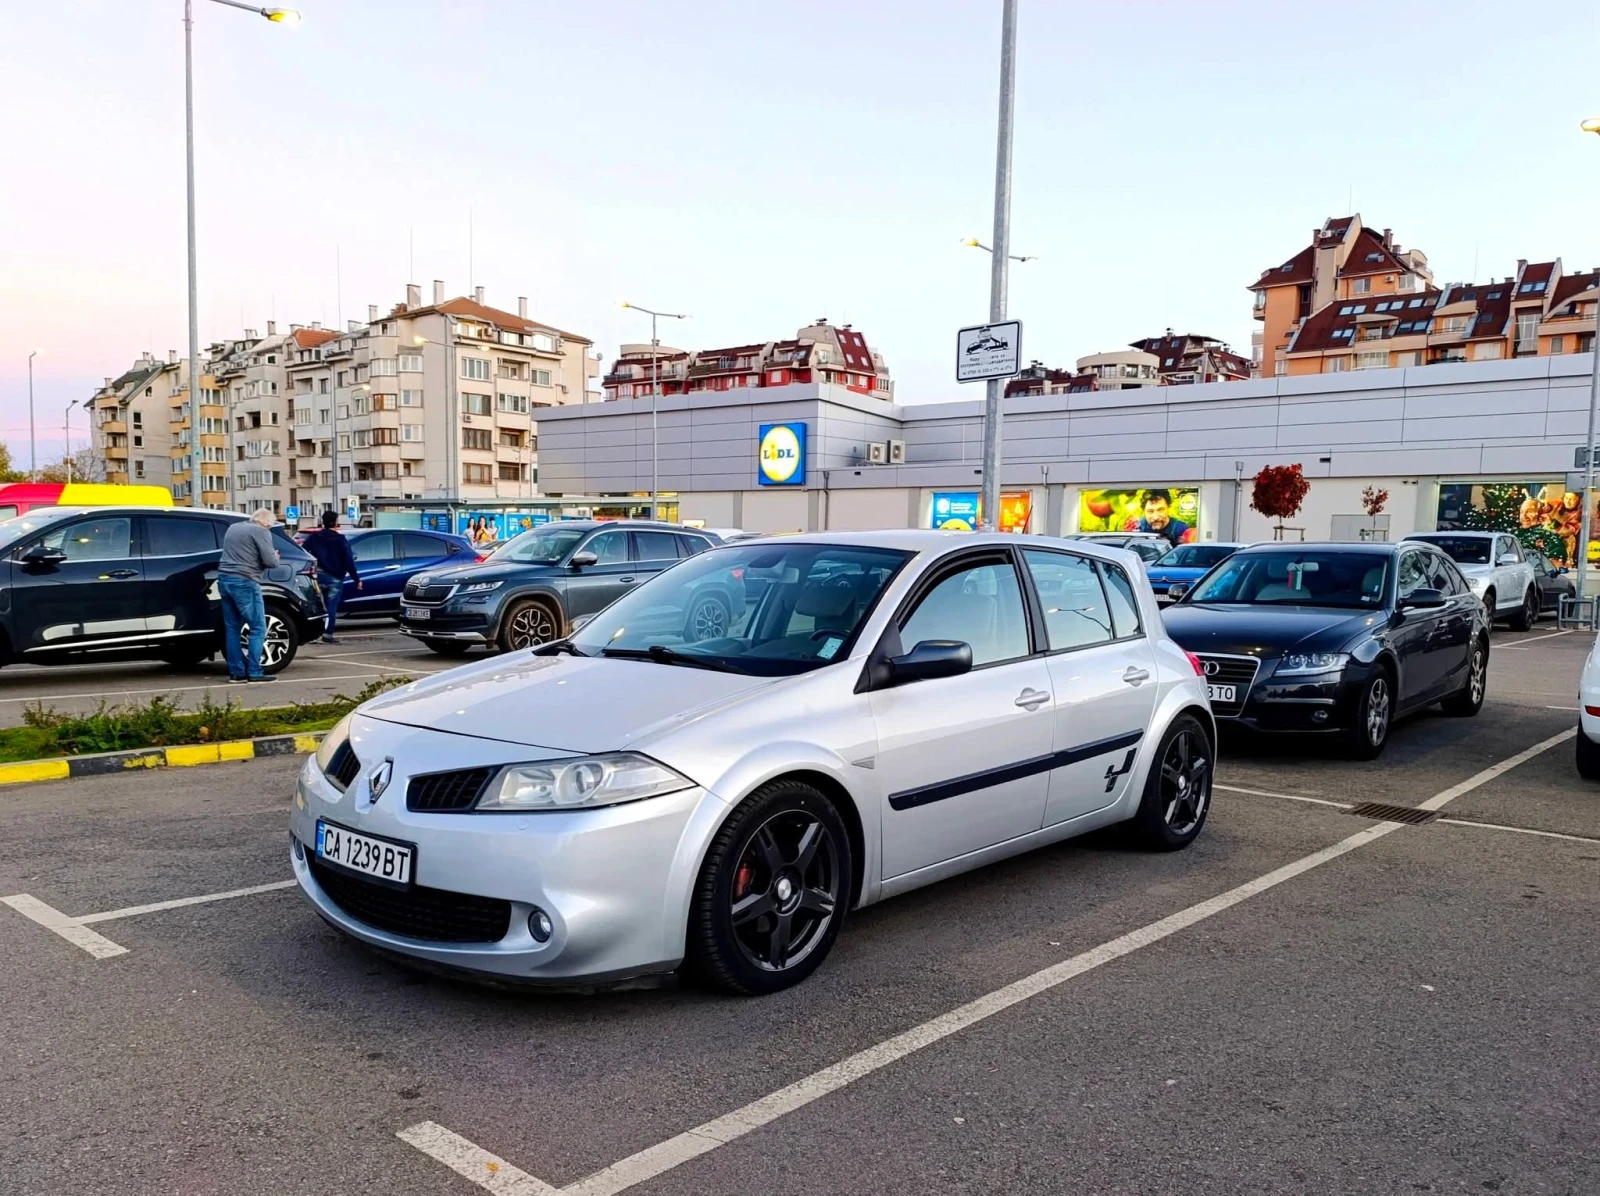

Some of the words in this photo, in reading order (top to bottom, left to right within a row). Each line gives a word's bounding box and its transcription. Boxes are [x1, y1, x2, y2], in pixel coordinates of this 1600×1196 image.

[324, 829, 340, 860] CA
[346, 836, 381, 873] 1239
[382, 847, 409, 880] BT
